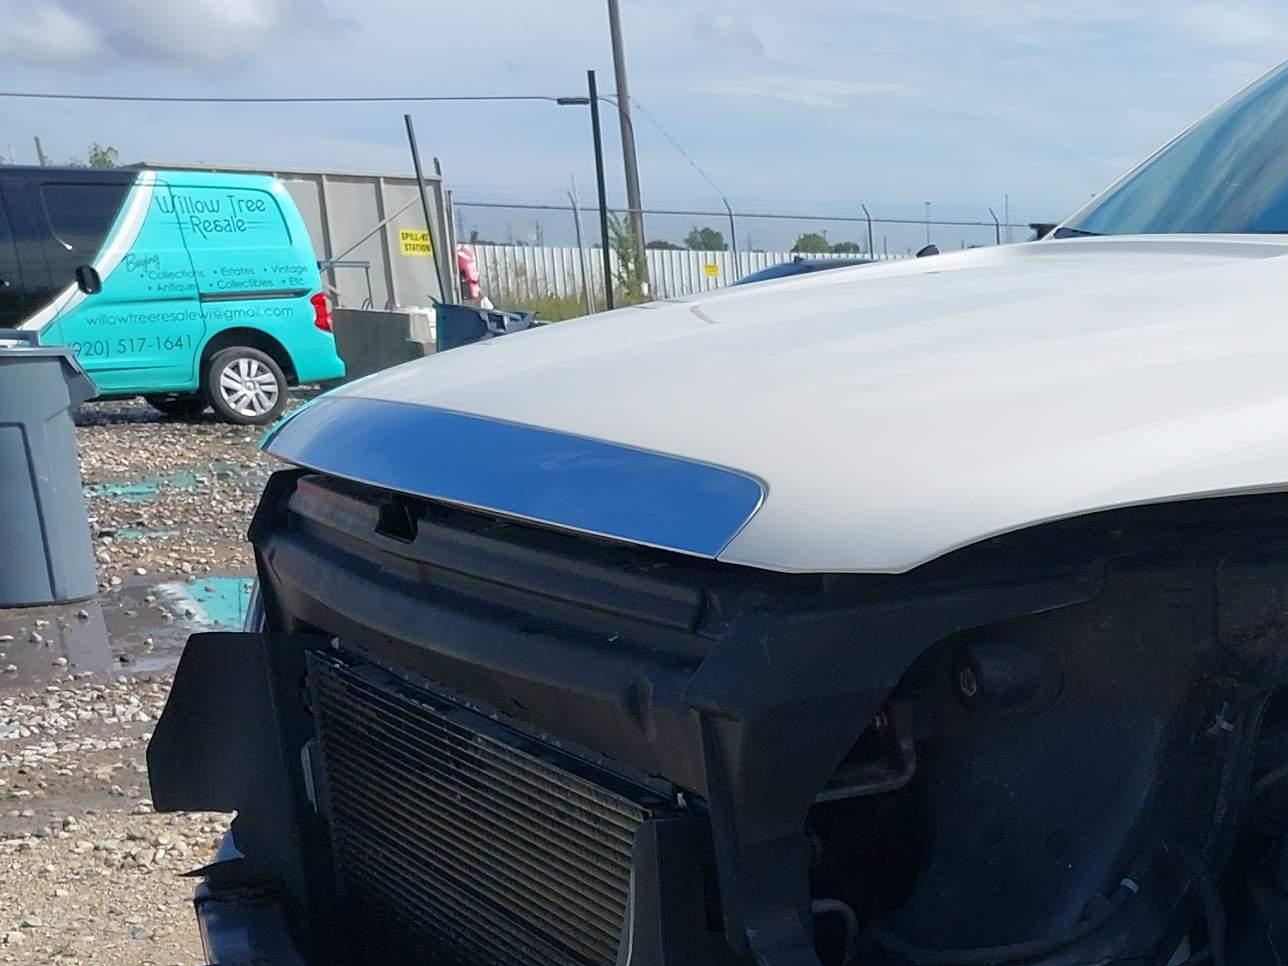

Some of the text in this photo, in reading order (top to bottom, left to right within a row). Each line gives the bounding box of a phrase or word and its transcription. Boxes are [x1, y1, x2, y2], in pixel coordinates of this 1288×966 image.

[155, 194, 266, 218] Willow Tree
[189, 215, 247, 240] Resale
[122, 253, 160, 273] Buying
[220, 266, 256, 277] Estates
[117, 334, 193, 354] 517-1641
